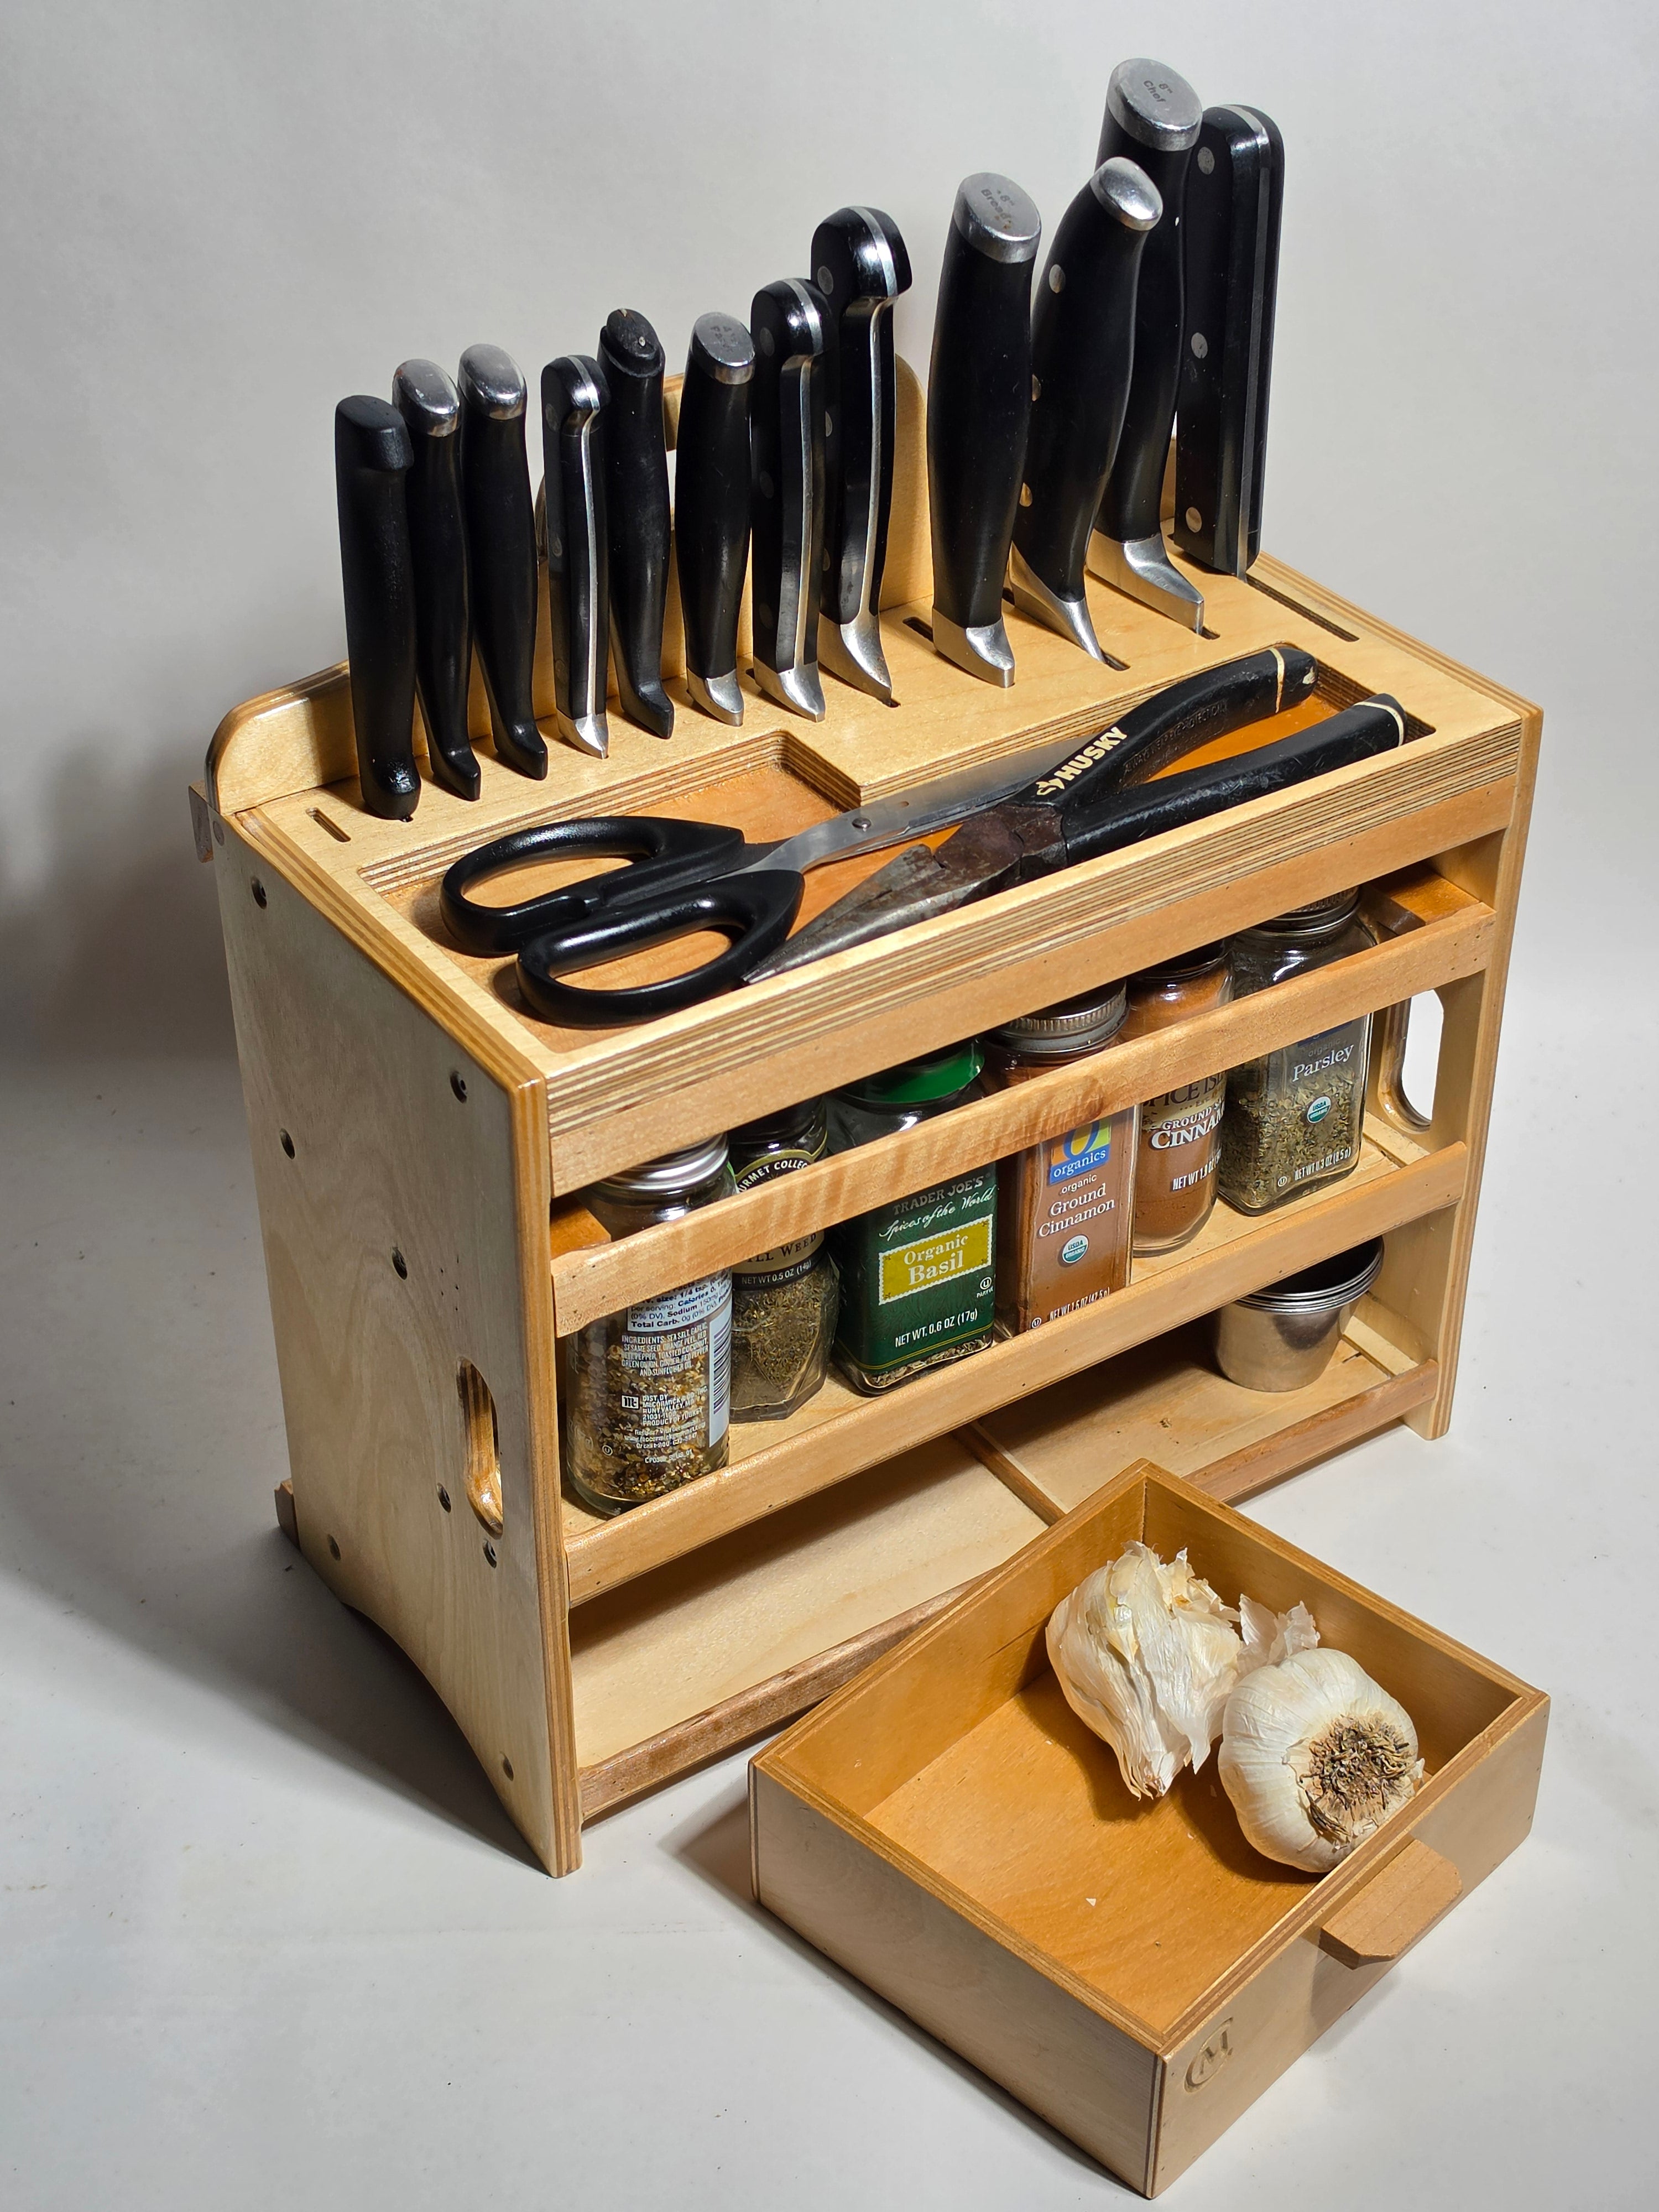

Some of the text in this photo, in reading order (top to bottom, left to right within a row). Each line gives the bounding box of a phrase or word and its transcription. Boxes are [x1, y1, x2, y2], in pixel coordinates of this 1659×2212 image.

[1143, 80, 1166, 102] Chef
[981, 189, 1011, 220] Bread
[1054, 727, 1128, 781] HUSKY
[1292, 1044, 1354, 1082] Parsley
[1162, 1107, 1212, 1130] GROUND
[1053, 1149, 1107, 1178] organics
[1306, 1162, 1315, 1176] WT
[1325, 1154, 1333, 1167] OZ
[1061, 1174, 1097, 1194] organic
[1173, 1175, 1187, 1191] NET
[1188, 1170, 1199, 1186] WT
[893, 1188, 945, 1215] TRADER
[1050, 1183, 1107, 1216] Ground
[879, 1219, 922, 1241] Spices
[961, 1184, 997, 1210] World
[1039, 1199, 1115, 1237] Cinnamon
[780, 1233, 816, 1258] WEED
[904, 1234, 968, 1265] Organic
[1068, 1240, 1083, 1250] USDA
[742, 1276, 756, 1285] NET
[758, 1275, 770, 1285] WT
[772, 1272, 784, 1282] 0.5
[785, 1268, 794, 1278] OZ
[908, 1250, 964, 1286] Basil
[667, 1304, 697, 1318] Sodium
[677, 1291, 708, 1307] Calories
[656, 1318, 680, 1327] Carb.
[681, 1314, 691, 1322] 0g
[895, 1308, 978, 1348] NET WT. 0.6 OZ (17g)
[622, 1334, 665, 1344] INGREDIENTS:
[643, 1417, 673, 1427] PRODUCT
